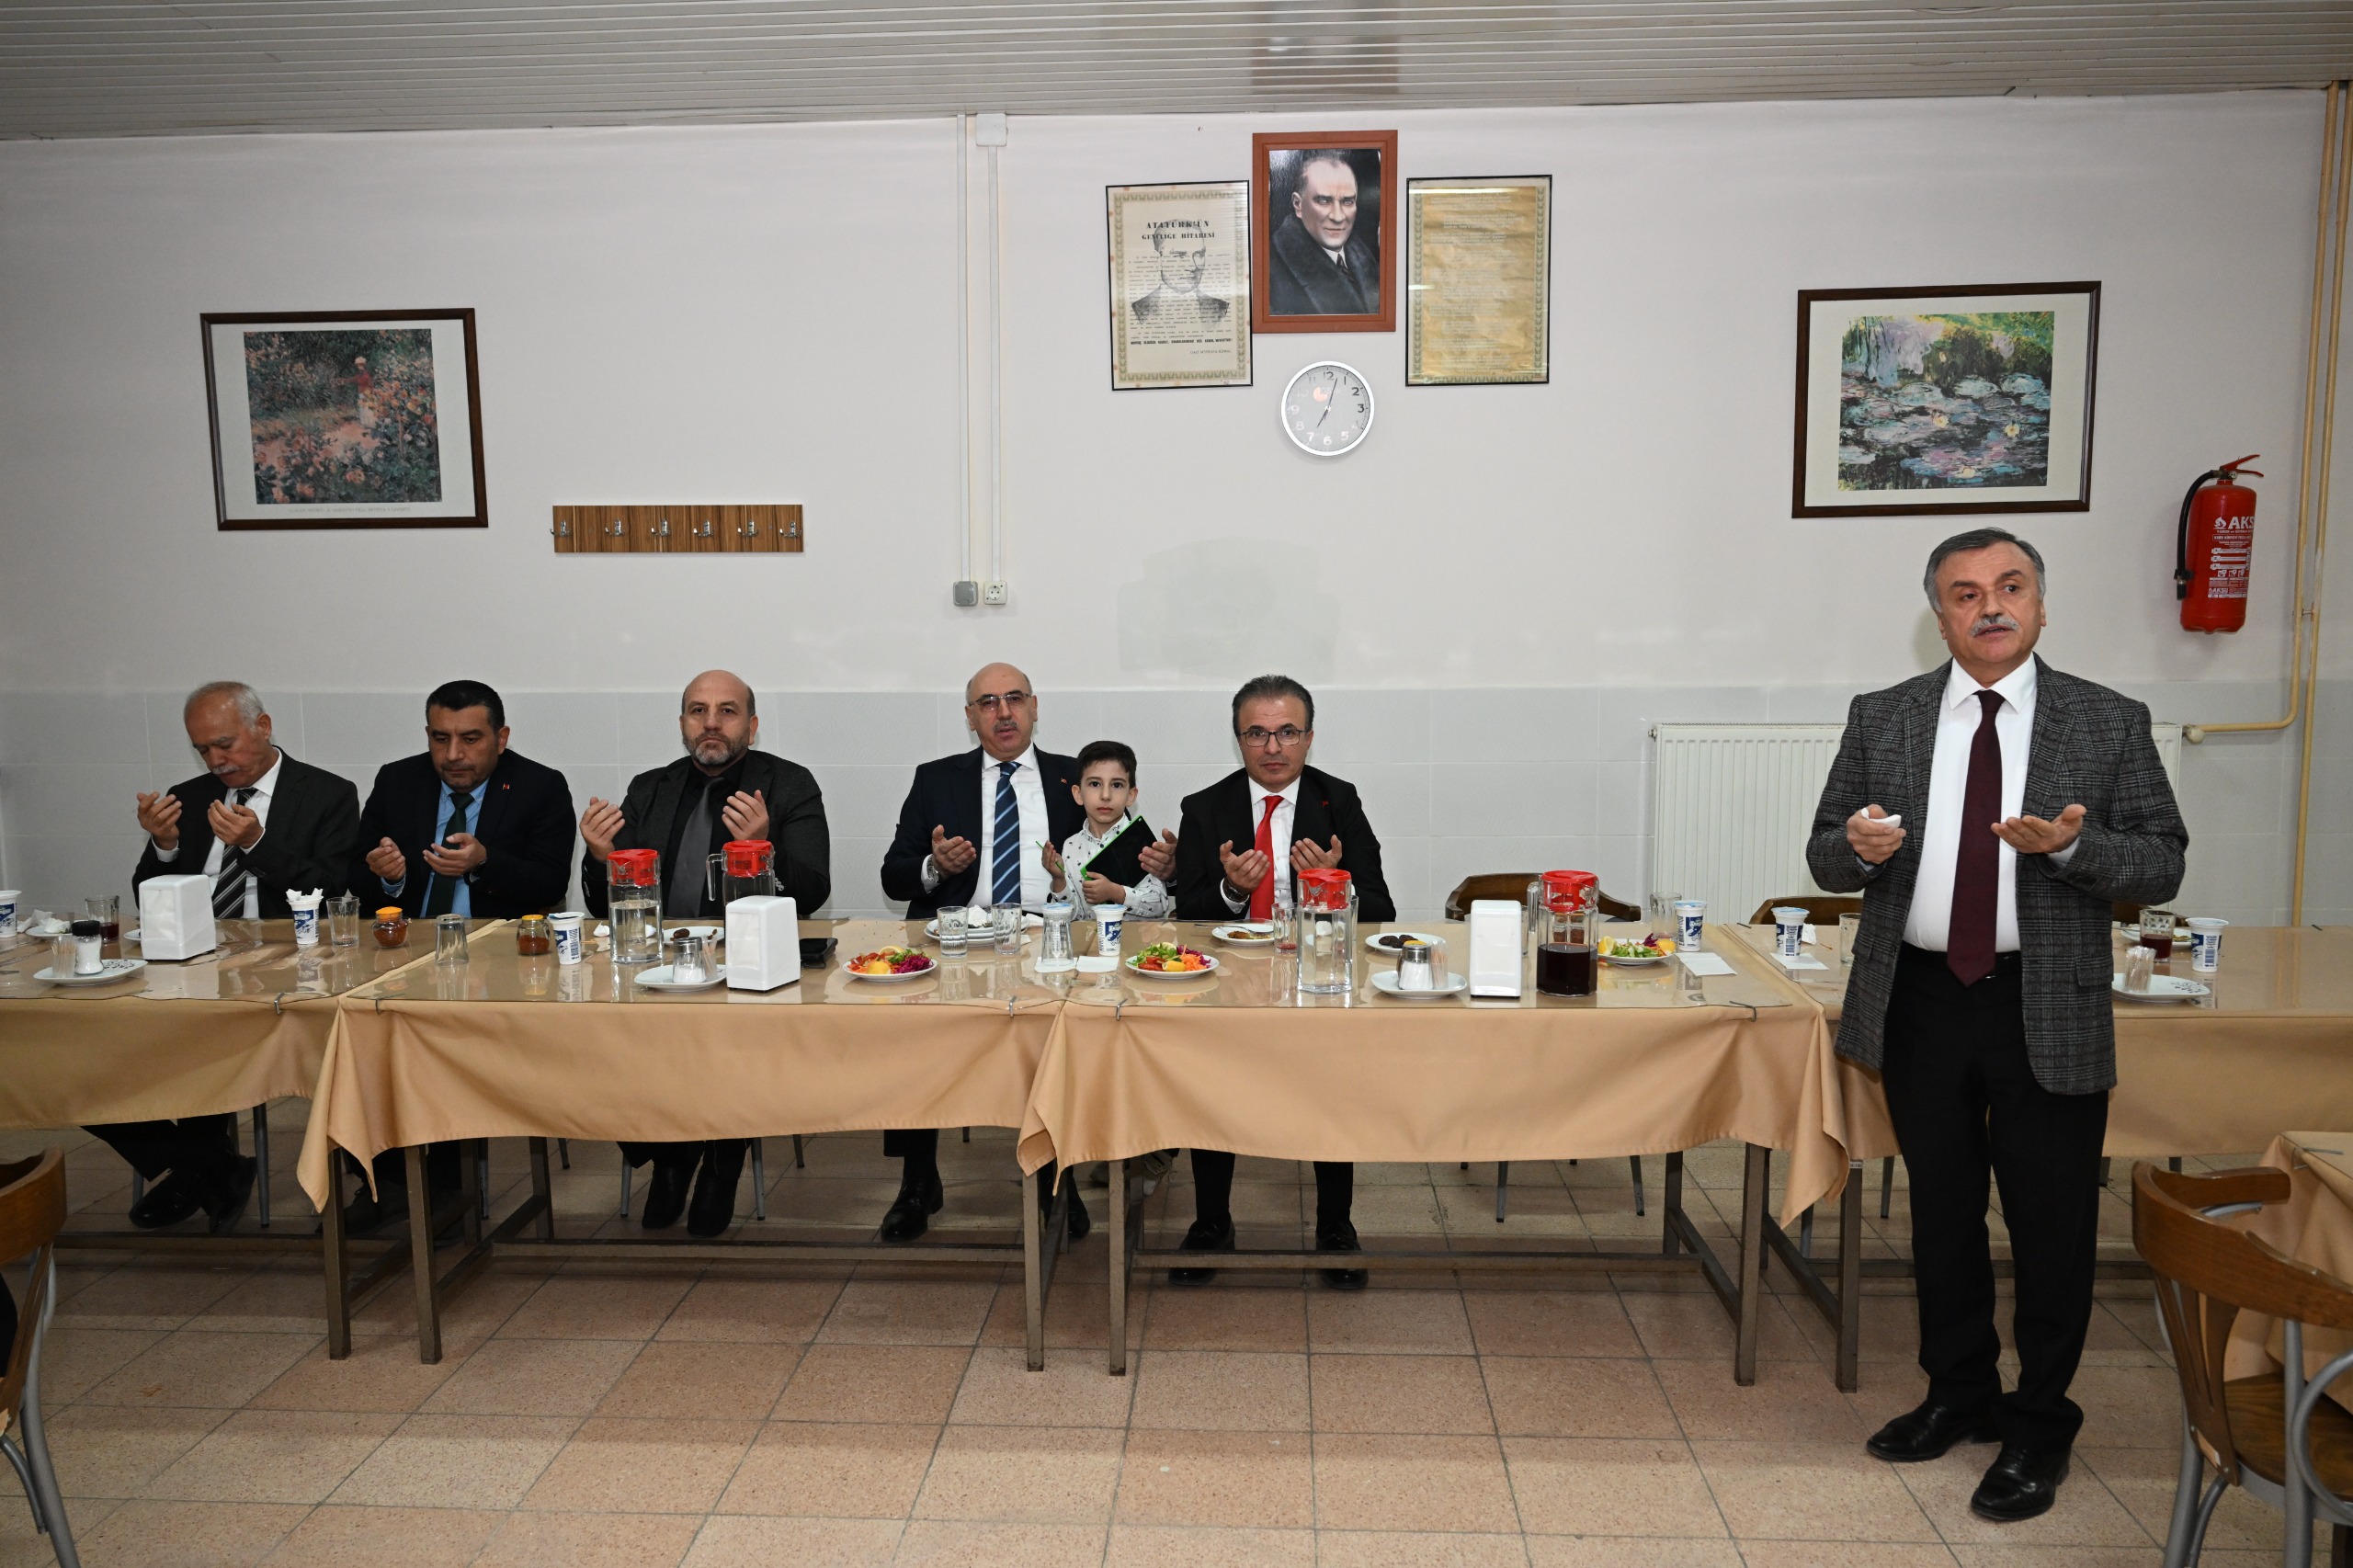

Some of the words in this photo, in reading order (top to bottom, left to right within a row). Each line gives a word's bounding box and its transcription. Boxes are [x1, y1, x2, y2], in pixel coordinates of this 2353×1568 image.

[1324, 371, 1335, 381] 12
[1351, 386, 1360, 396] 2
[1290, 404, 1300, 415] 9
[1357, 403, 1365, 414] 3
[1295, 421, 1305, 431] 8
[1306, 432, 1315, 442] 7
[1323, 436, 1333, 446] 6
[1341, 431, 1349, 441] 5
